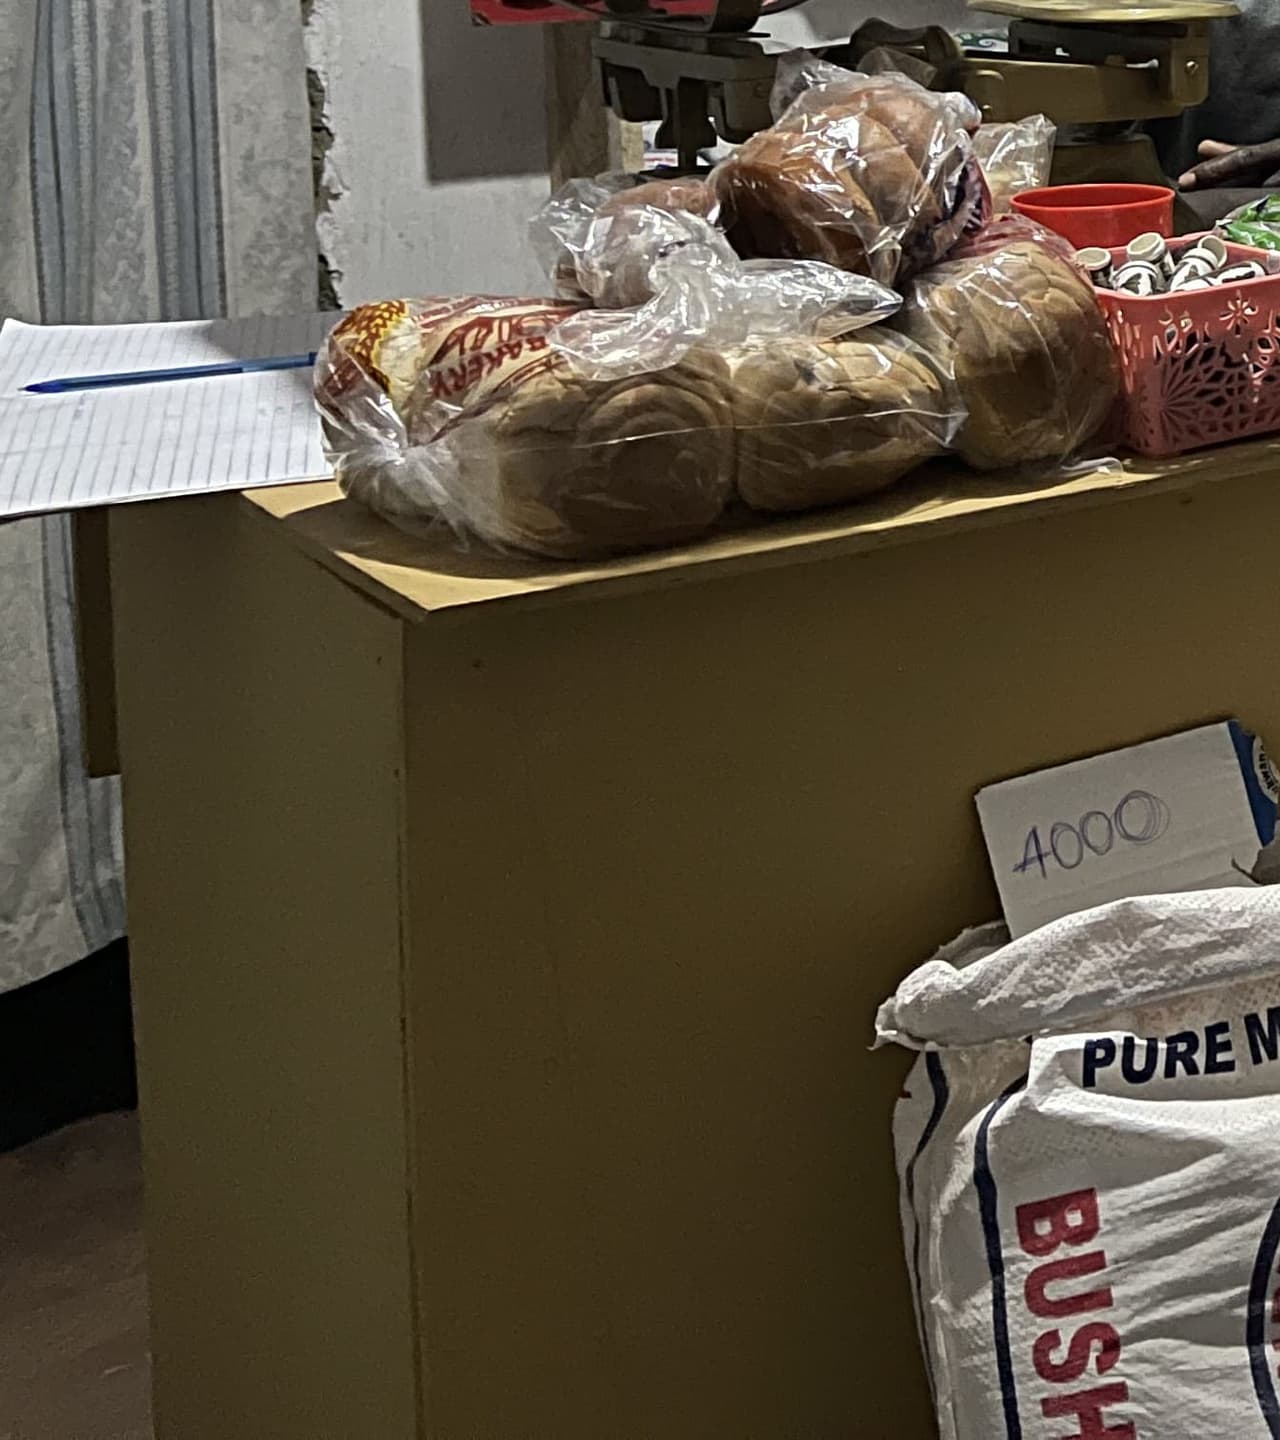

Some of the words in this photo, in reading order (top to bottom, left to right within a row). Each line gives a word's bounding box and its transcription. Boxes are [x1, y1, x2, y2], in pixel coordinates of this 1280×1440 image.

[430, 336, 549, 398] BAKERY
[1012, 788, 1170, 880] 4000
[1083, 1020, 1236, 1089] PURE
